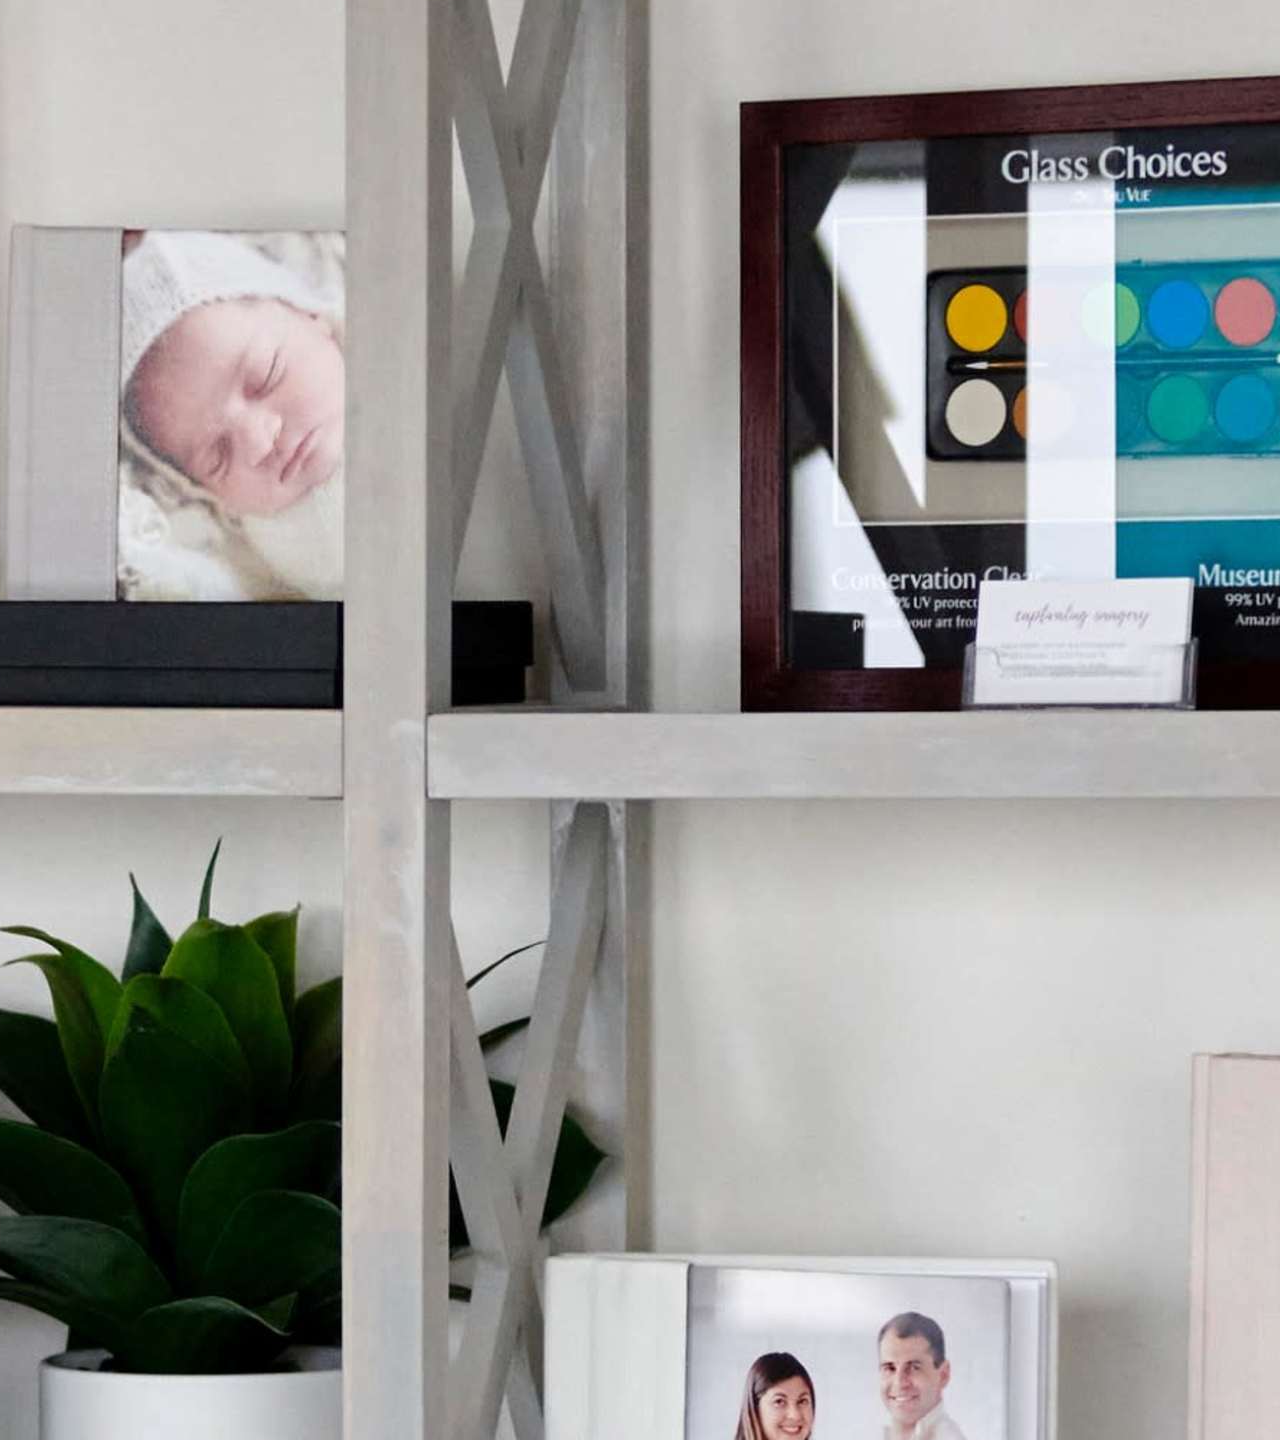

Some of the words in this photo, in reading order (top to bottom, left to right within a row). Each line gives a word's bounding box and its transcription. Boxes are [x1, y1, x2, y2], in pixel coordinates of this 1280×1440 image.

[1001, 148, 1089, 184] Glass
[1098, 143, 1228, 180] Choices
[913, 596, 931, 609] UV
[1225, 593, 1253, 607] 99%
[1255, 593, 1274, 607] UV
[935, 618, 953, 629] art
